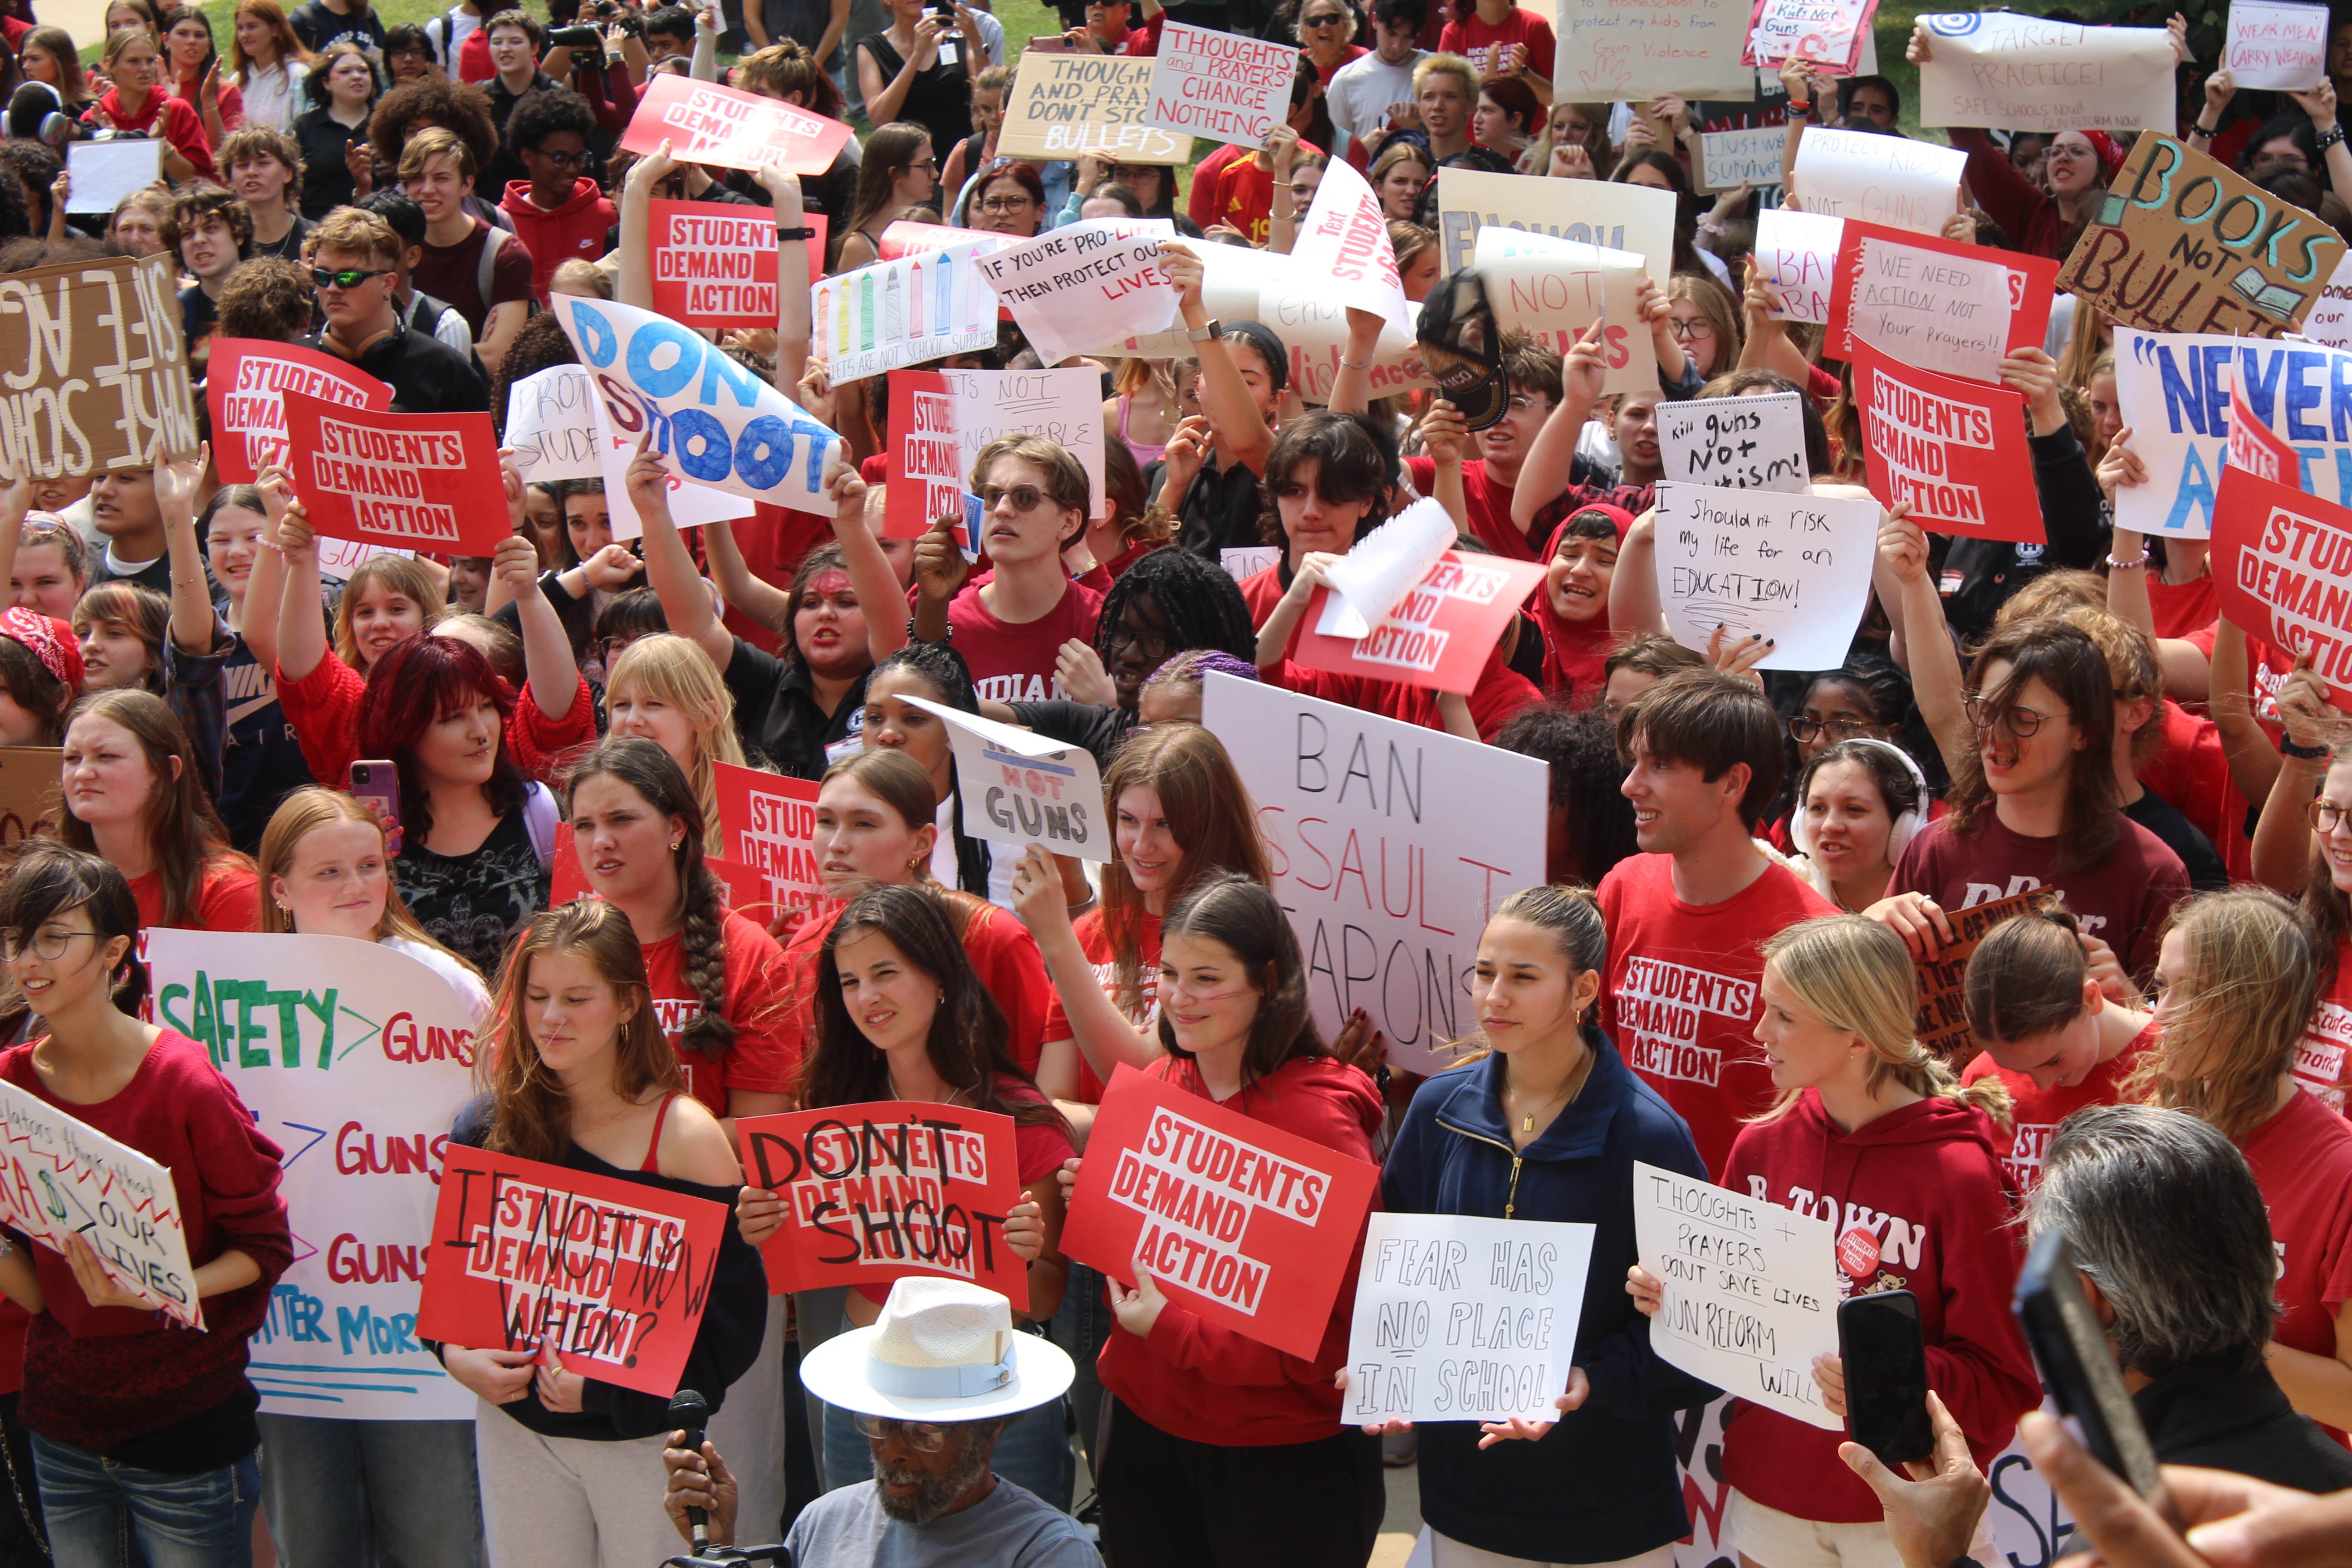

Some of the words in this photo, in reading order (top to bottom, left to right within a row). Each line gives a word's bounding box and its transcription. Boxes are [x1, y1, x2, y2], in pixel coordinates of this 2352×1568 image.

[1572, 15, 1621, 29] protect
[1630, 20, 1645, 30] my
[1651, 13, 1681, 28] kids
[1689, 15, 1716, 28] from
[1765, 19, 1798, 34] Guns
[1776, 3, 1806, 20] Kids
[1811, 9, 1837, 21] Not
[2236, 22, 2278, 40] WEAK
[2282, 24, 2321, 41] MEN
[1593, 38, 1630, 54] Gun
[1642, 41, 1711, 59] Violence
[1990, 24, 2085, 52] TARGET
[2230, 41, 2270, 69] CARRY
[1050, 59, 1149, 85] THOUGH
[1166, 55, 1194, 72] and
[1971, 62, 2104, 89] PRACTICE!
[1182, 76, 1268, 111] CHANGE
[1953, 96, 1990, 116] SAFE
[1998, 102, 2048, 117] SCHOOLS
[1044, 122, 1176, 157] BULLETS
[1155, 97, 1272, 138] NOTHING
[2043, 118, 2066, 130] GUN
[2068, 115, 2113, 128] REFORM
[1810, 134, 1879, 155] PROTECT
[1889, 135, 1941, 176] KIDS
[1317, 210, 1348, 238] Text
[1861, 186, 1928, 226] GUNS
[2130, 139, 2337, 283] BOOKS
[672, 218, 779, 248] STUDENT
[659, 251, 752, 279] DEMAND
[984, 260, 1004, 280] IF
[1009, 236, 1067, 272] YOU'RE
[1001, 281, 1043, 305] THEN
[1053, 252, 1127, 292] PROTECT
[1878, 250, 1911, 278] WE
[1921, 265, 1971, 287] NEED
[690, 284, 773, 313] ACTION
[1511, 271, 1604, 313] NOT
[1865, 284, 1936, 310] ACTION
[1945, 299, 1981, 319] NOT
[82, 261, 179, 377] SAFE
[2315, 311, 2344, 323] our
[858, 352, 877, 372] ARE
[880, 345, 900, 368] NOT
[907, 337, 946, 366] SCHOOL
[952, 329, 996, 348] SUPPLIES
[998, 374, 1052, 400] NOT
[99, 364, 199, 468] MAKE
[1672, 421, 1694, 441] Kill
[1705, 411, 1761, 447] guns
[1875, 374, 1991, 445] STUDENTS
[323, 421, 462, 466] STUDENTS
[598, 373, 843, 494] SHOOT
[1870, 412, 1944, 477] DEMAND
[315, 455, 421, 499] DEMAND
[1891, 469, 1980, 520] ACTION
[361, 500, 455, 537] ACTION
[1655, 485, 1673, 513] I
[1790, 510, 1831, 533] risk
[1680, 529, 1699, 557] my
[1714, 534, 1740, 556] life
[1757, 540, 1784, 559] for
[1802, 548, 1833, 565] an
[1672, 566, 1800, 609] EDUCATION!
[1356, 627, 1443, 667] ACTION
[228, 664, 274, 699] NIK
[1000, 765, 1065, 803] NOT
[1296, 712, 1423, 824] BAN
[985, 786, 1088, 844] GUNS
[1256, 805, 1513, 922] SSAULT
[1626, 956, 1754, 1018] STUDENTS
[160, 970, 338, 1071] SAFETY
[382, 1011, 475, 1067] GUNS
[1616, 997, 1698, 1042] DEMAND
[1634, 1036, 1720, 1085] ACTION
[750, 1114, 962, 1190] DON'T
[813, 1126, 985, 1181] STUDENTS
[1147, 1114, 1323, 1218] STUDENTS
[796, 1175, 941, 1222] DEMAND
[1113, 1155, 1246, 1244] DEMAND
[99, 1200, 166, 1256] OUR
[444, 1167, 520, 1261] IF
[525, 1189, 636, 1290] NOT
[633, 1221, 718, 1324] NOW
[500, 1185, 681, 1269] STUDENTS
[813, 1199, 1008, 1274] SHOOT
[1847, 1232, 1878, 1259] STUDENTS
[93, 1231, 187, 1305] LIVES
[470, 1230, 610, 1301] DEMAND
[1138, 1224, 1264, 1308] ACTION
[1374, 1239, 1467, 1291] FEAR
[1490, 1241, 1557, 1296] HAS
[1842, 1240, 1864, 1259] DEMAND
[1843, 1251, 1866, 1271] ACTION
[1661, 1254, 1706, 1283] DONT
[1720, 1270, 1762, 1297] SAVE
[1773, 1288, 1820, 1313] LIVES
[499, 1278, 658, 1369] WHEN?
[1376, 1300, 1430, 1348] NO
[1446, 1302, 1554, 1351] PLACE
[1661, 1281, 1700, 1337] GUN
[1706, 1303, 1776, 1356] REFORM
[1356, 1363, 1416, 1415] IN
[1434, 1359, 1545, 1413] SCHOOL
[1760, 1362, 1818, 1406] WILL
